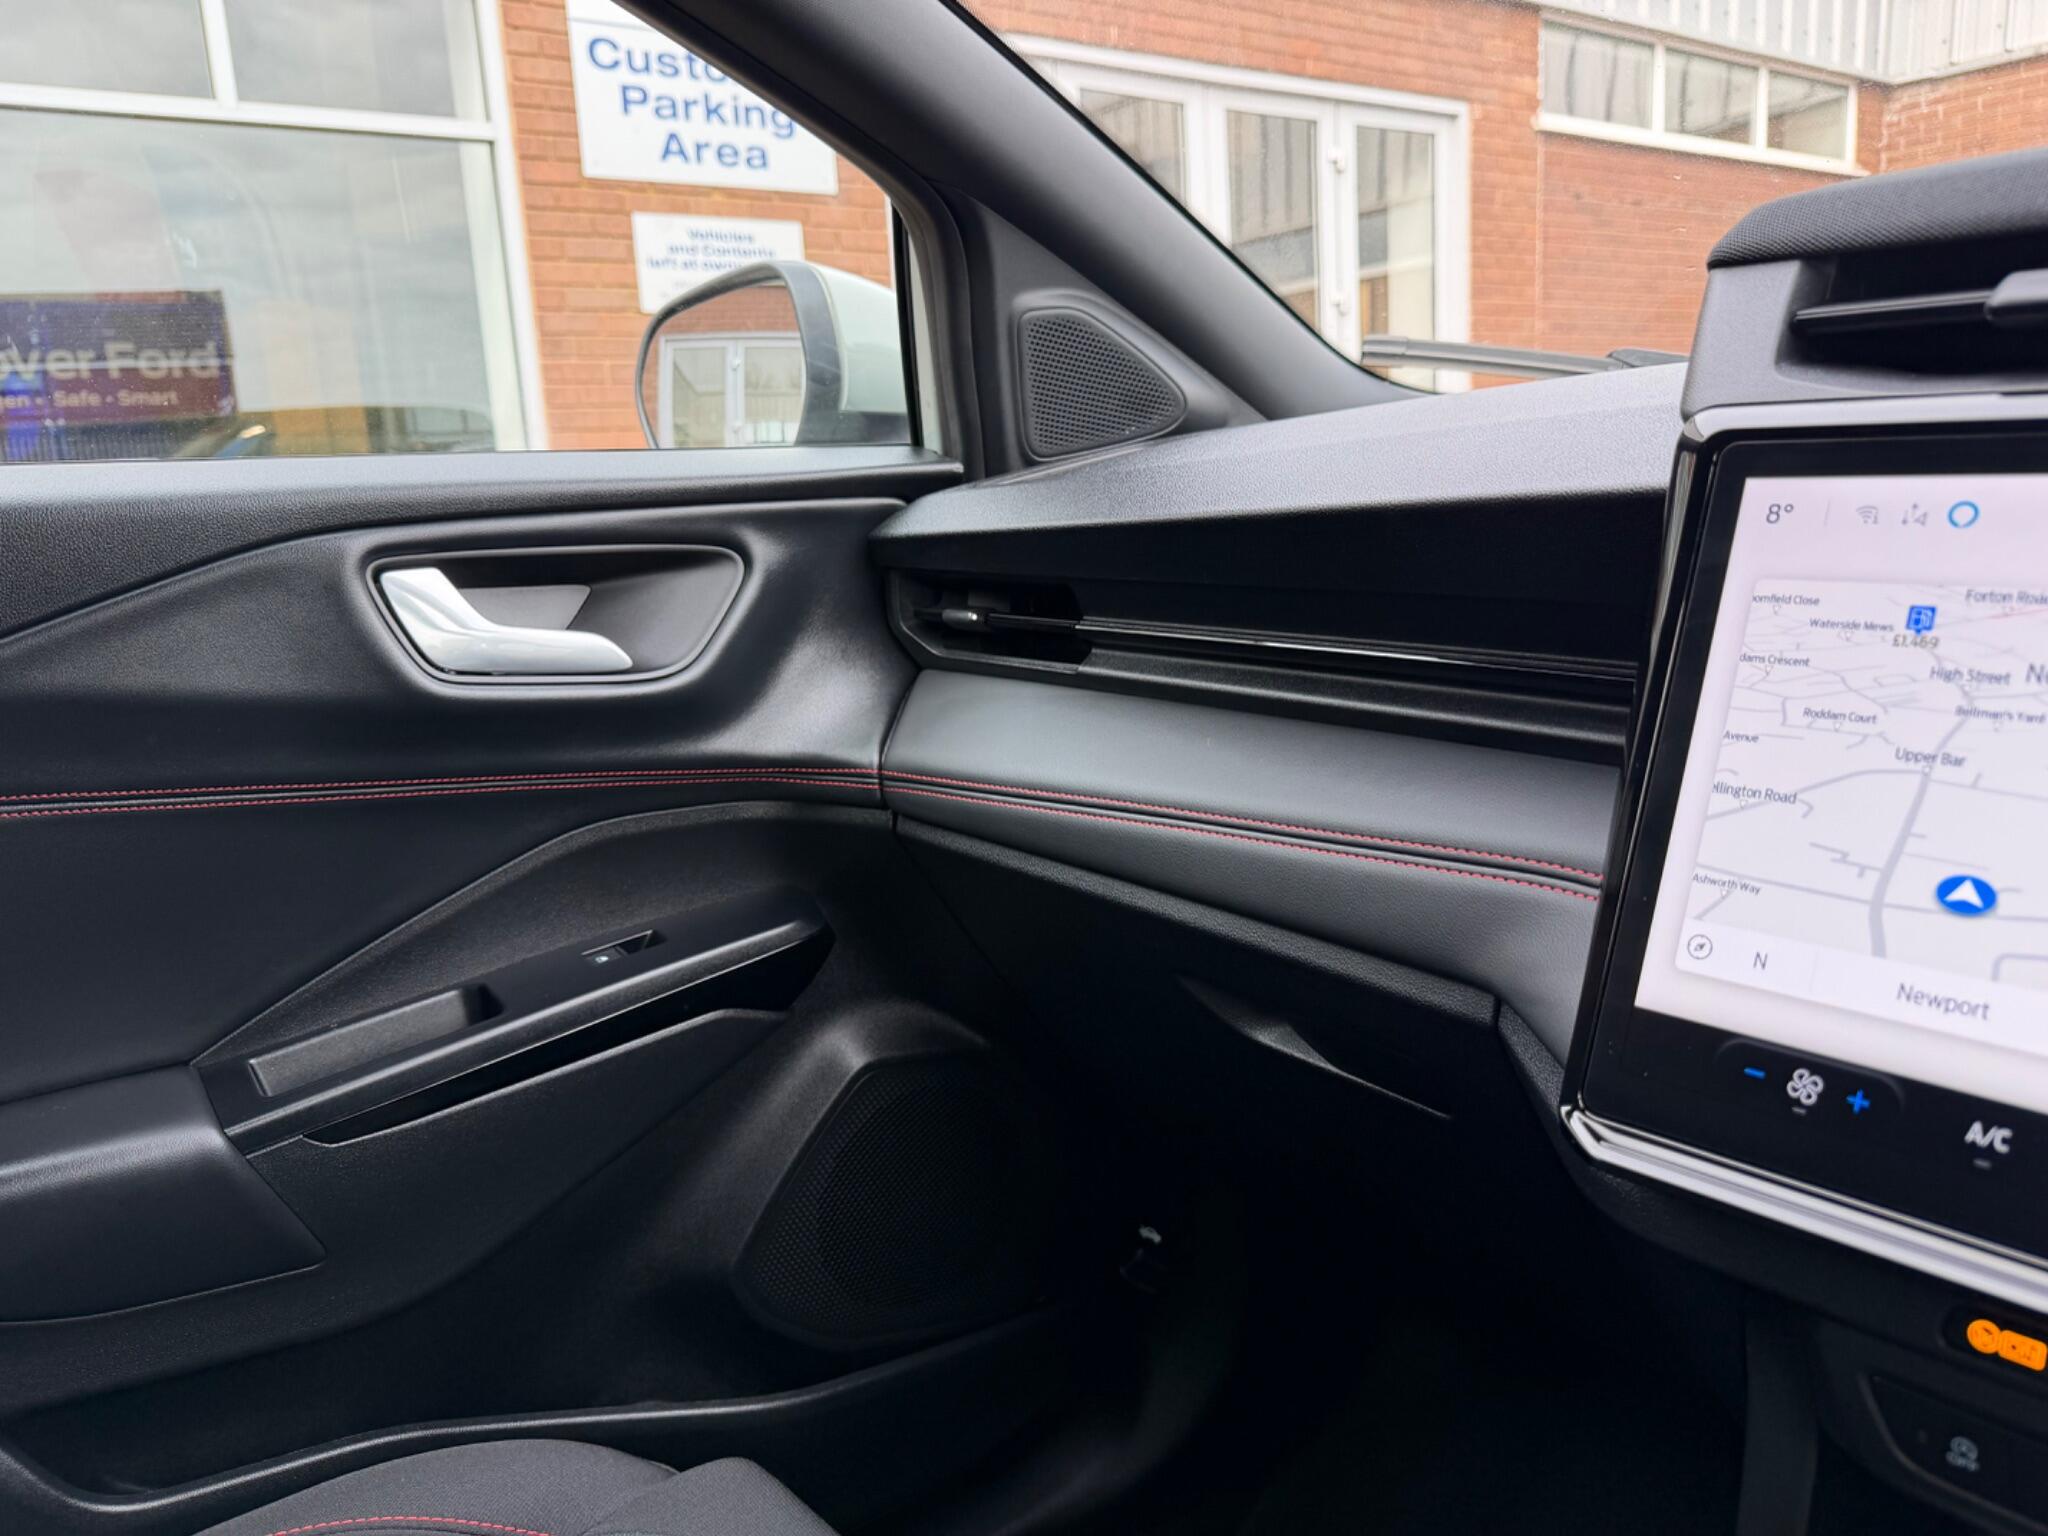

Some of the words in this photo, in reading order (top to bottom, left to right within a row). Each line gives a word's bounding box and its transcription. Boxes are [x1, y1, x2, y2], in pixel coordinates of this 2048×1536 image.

[621, 84, 796, 140] Parking
[660, 132, 769, 170] Area
[104, 340, 219, 379] Ford
[1766, 503, 1794, 524] 8°
[1794, 595, 1820, 606] Close
[1809, 618, 1861, 631] Waterside
[1864, 622, 1894, 633] Mews
[1768, 654, 1810, 667] Crescent
[1930, 665, 1963, 683] High
[1966, 669, 2011, 686] Street
[1803, 707, 1845, 721] Roddam
[1848, 712, 1877, 724] Court
[1723, 730, 1759, 743] Avenue
[1895, 747, 1938, 764] Upper
[1940, 752, 1966, 767] Bar
[1764, 788, 1798, 805] Road
[1692, 873, 1738, 890] Ashworth
[1740, 882, 1761, 896] Way
[1753, 952, 1768, 970] N
[1897, 983, 1990, 1021] Newport
[1964, 1120, 2014, 1155] A/C
